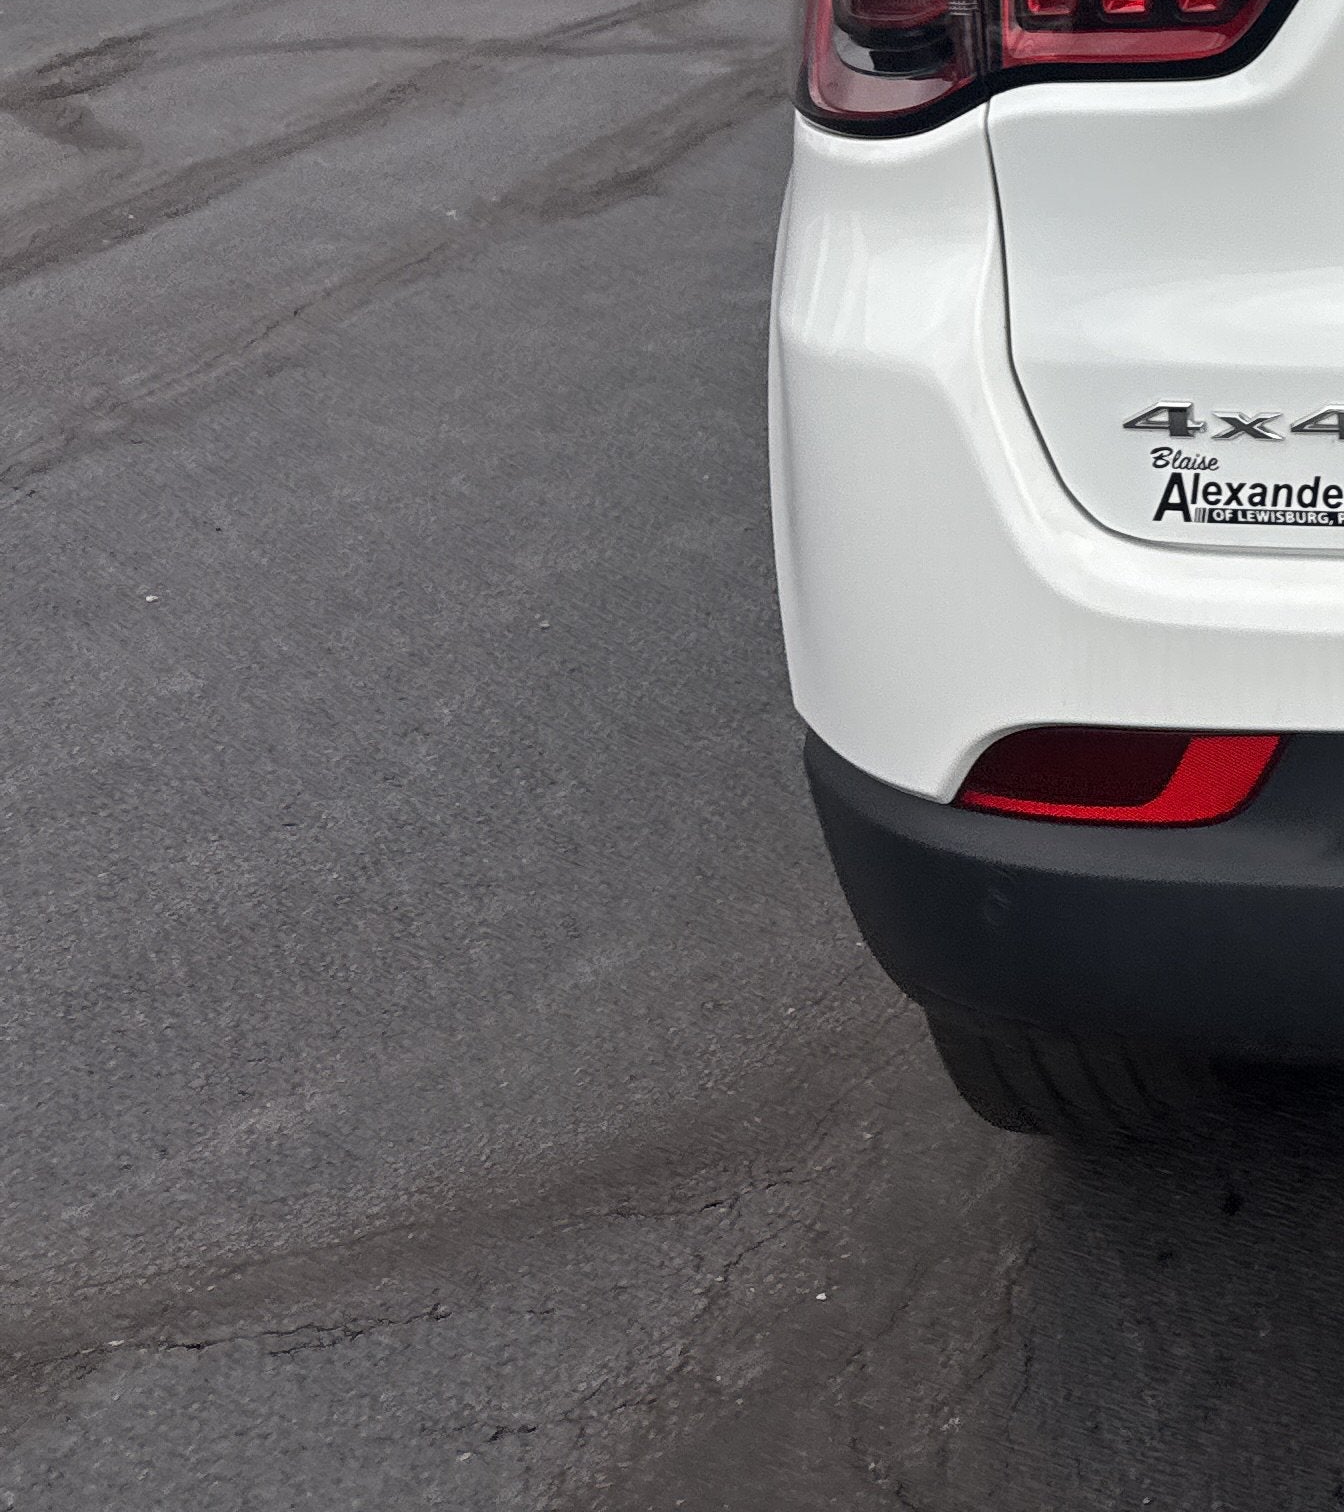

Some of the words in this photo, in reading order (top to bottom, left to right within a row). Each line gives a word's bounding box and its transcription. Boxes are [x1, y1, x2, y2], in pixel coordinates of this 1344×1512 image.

[1150, 447, 1219, 472] Blaise
[1212, 508, 1234, 522] OF
[1237, 510, 1334, 526] LEWISBURG,
